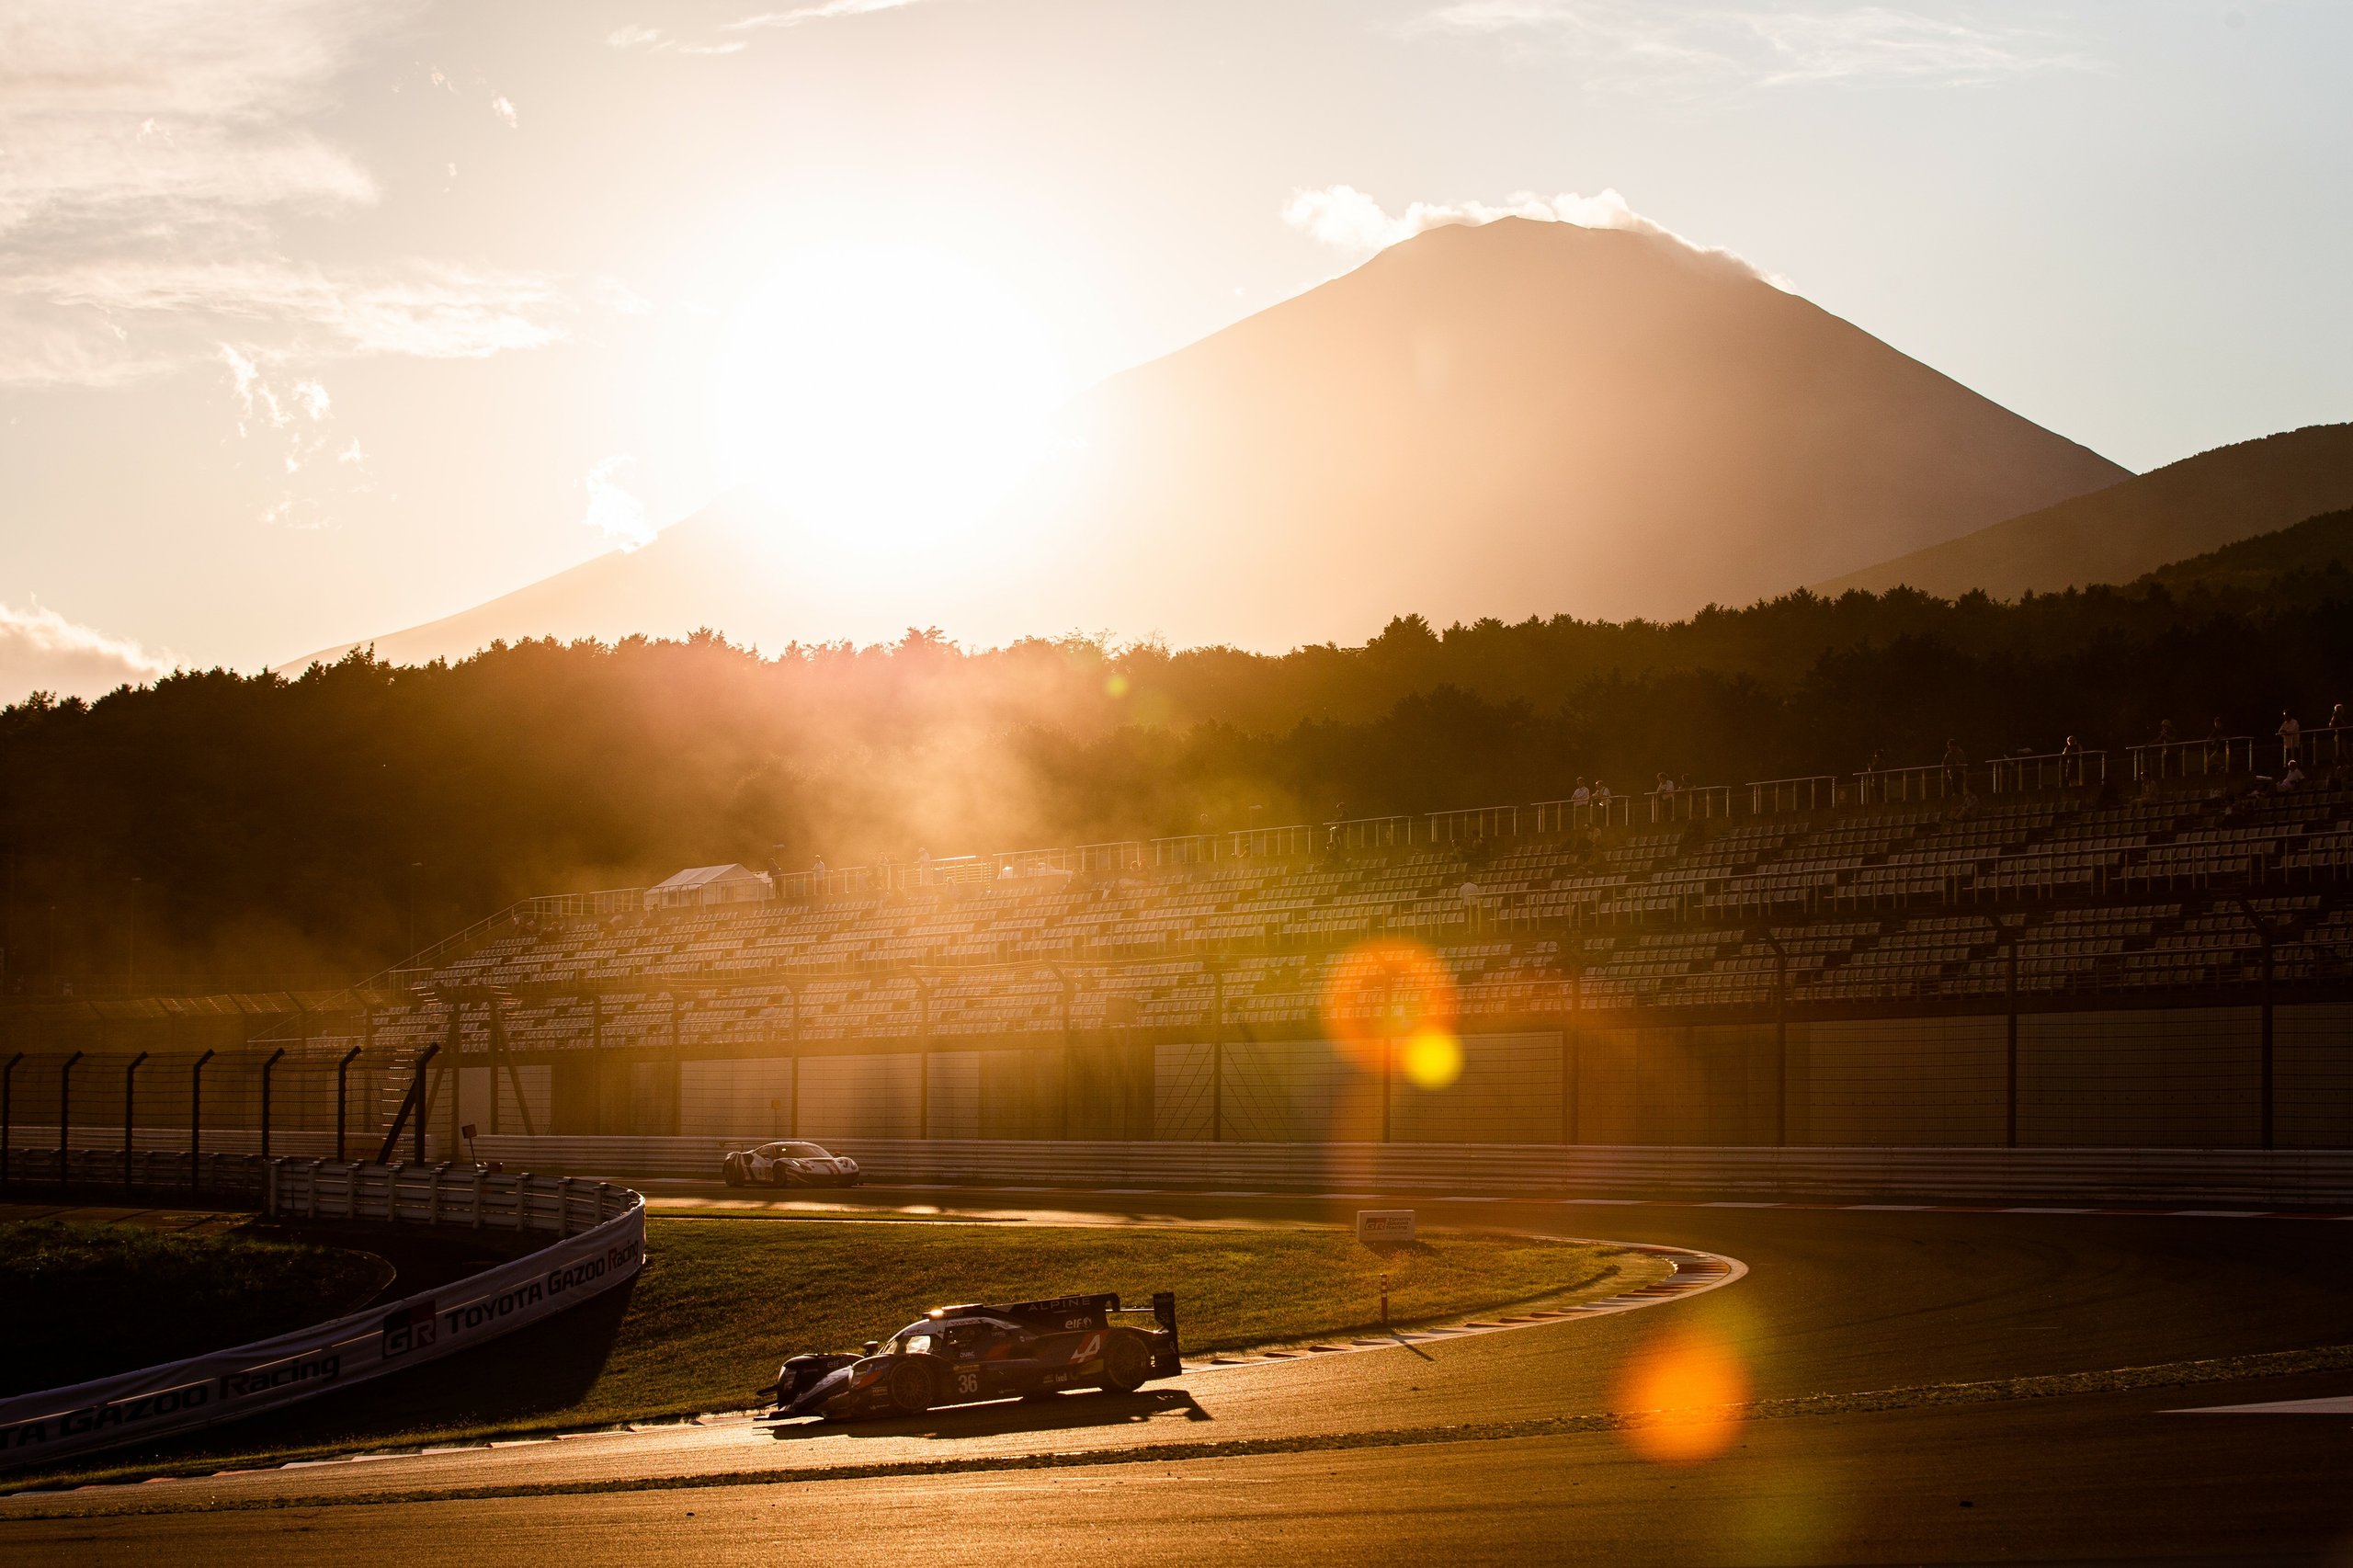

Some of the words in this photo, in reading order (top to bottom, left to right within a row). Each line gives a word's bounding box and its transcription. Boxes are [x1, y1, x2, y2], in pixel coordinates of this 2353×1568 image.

[384, 1318, 435, 1357] GR
[445, 1282, 542, 1334] TOYOTA
[548, 1257, 605, 1296] GAZOO
[608, 1239, 639, 1272] Racing
[1028, 1297, 1091, 1312] ALPINE
[1064, 1317, 1082, 1329] elf
[826, 1358, 840, 1369] elf
[958, 1373, 978, 1394] 36
[61, 1385, 208, 1437] GAZOO
[219, 1355, 340, 1400] Racing
